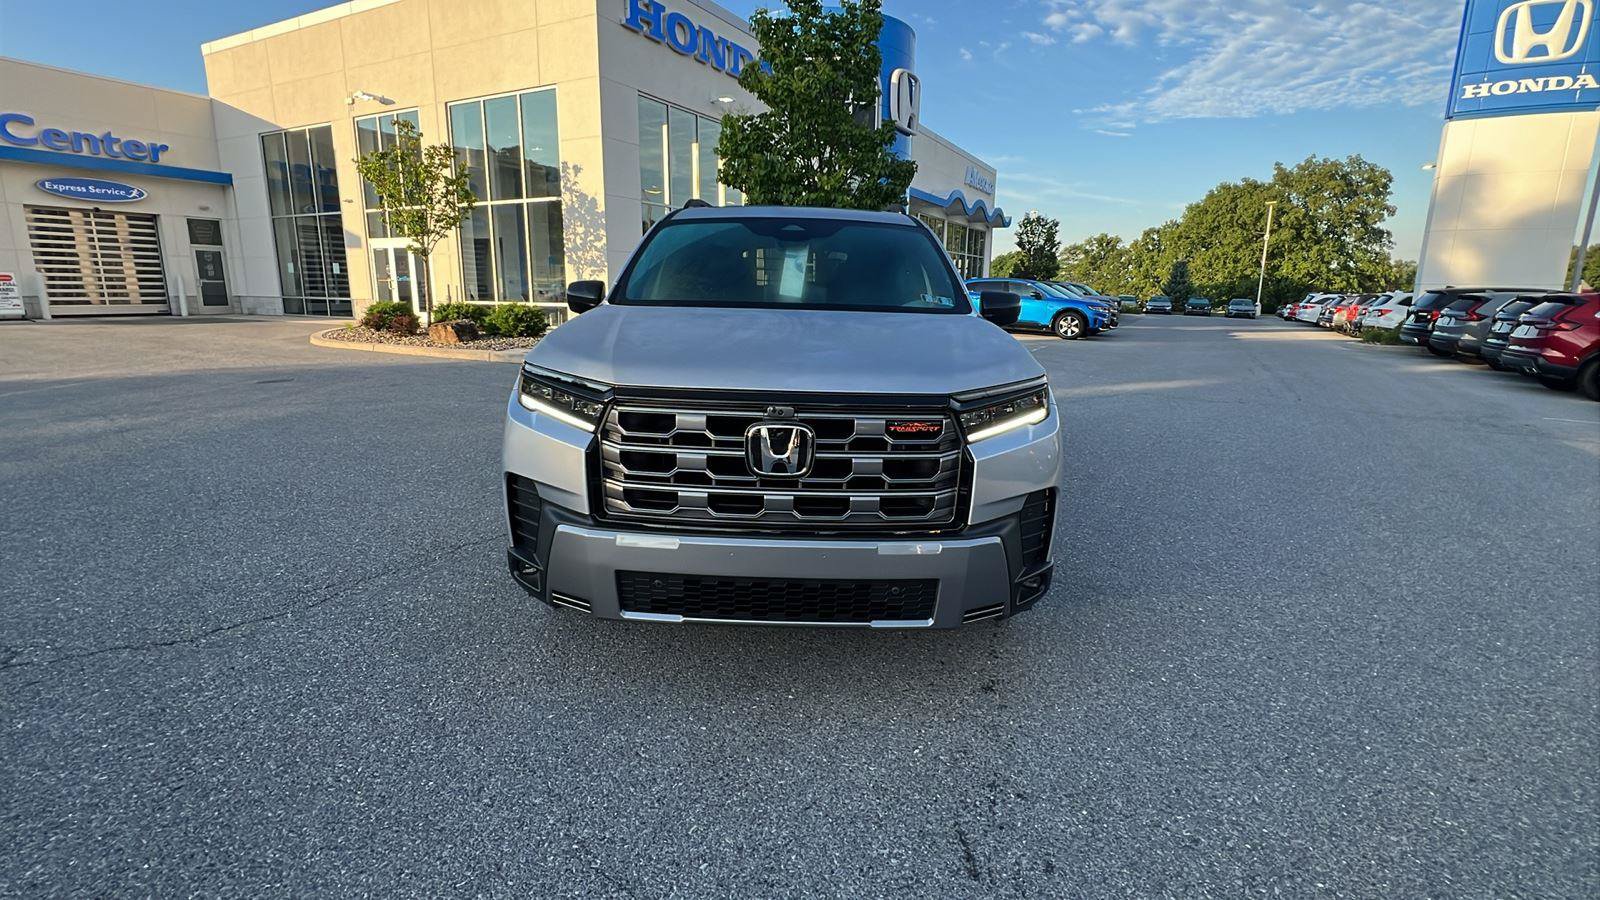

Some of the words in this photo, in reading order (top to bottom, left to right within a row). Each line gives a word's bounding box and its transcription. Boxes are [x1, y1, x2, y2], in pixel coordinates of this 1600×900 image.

[1462, 74, 1600, 99] HONDA
[0, 112, 168, 163] Center
[44, 182, 87, 194] Express
[88, 185, 126, 197] Service
